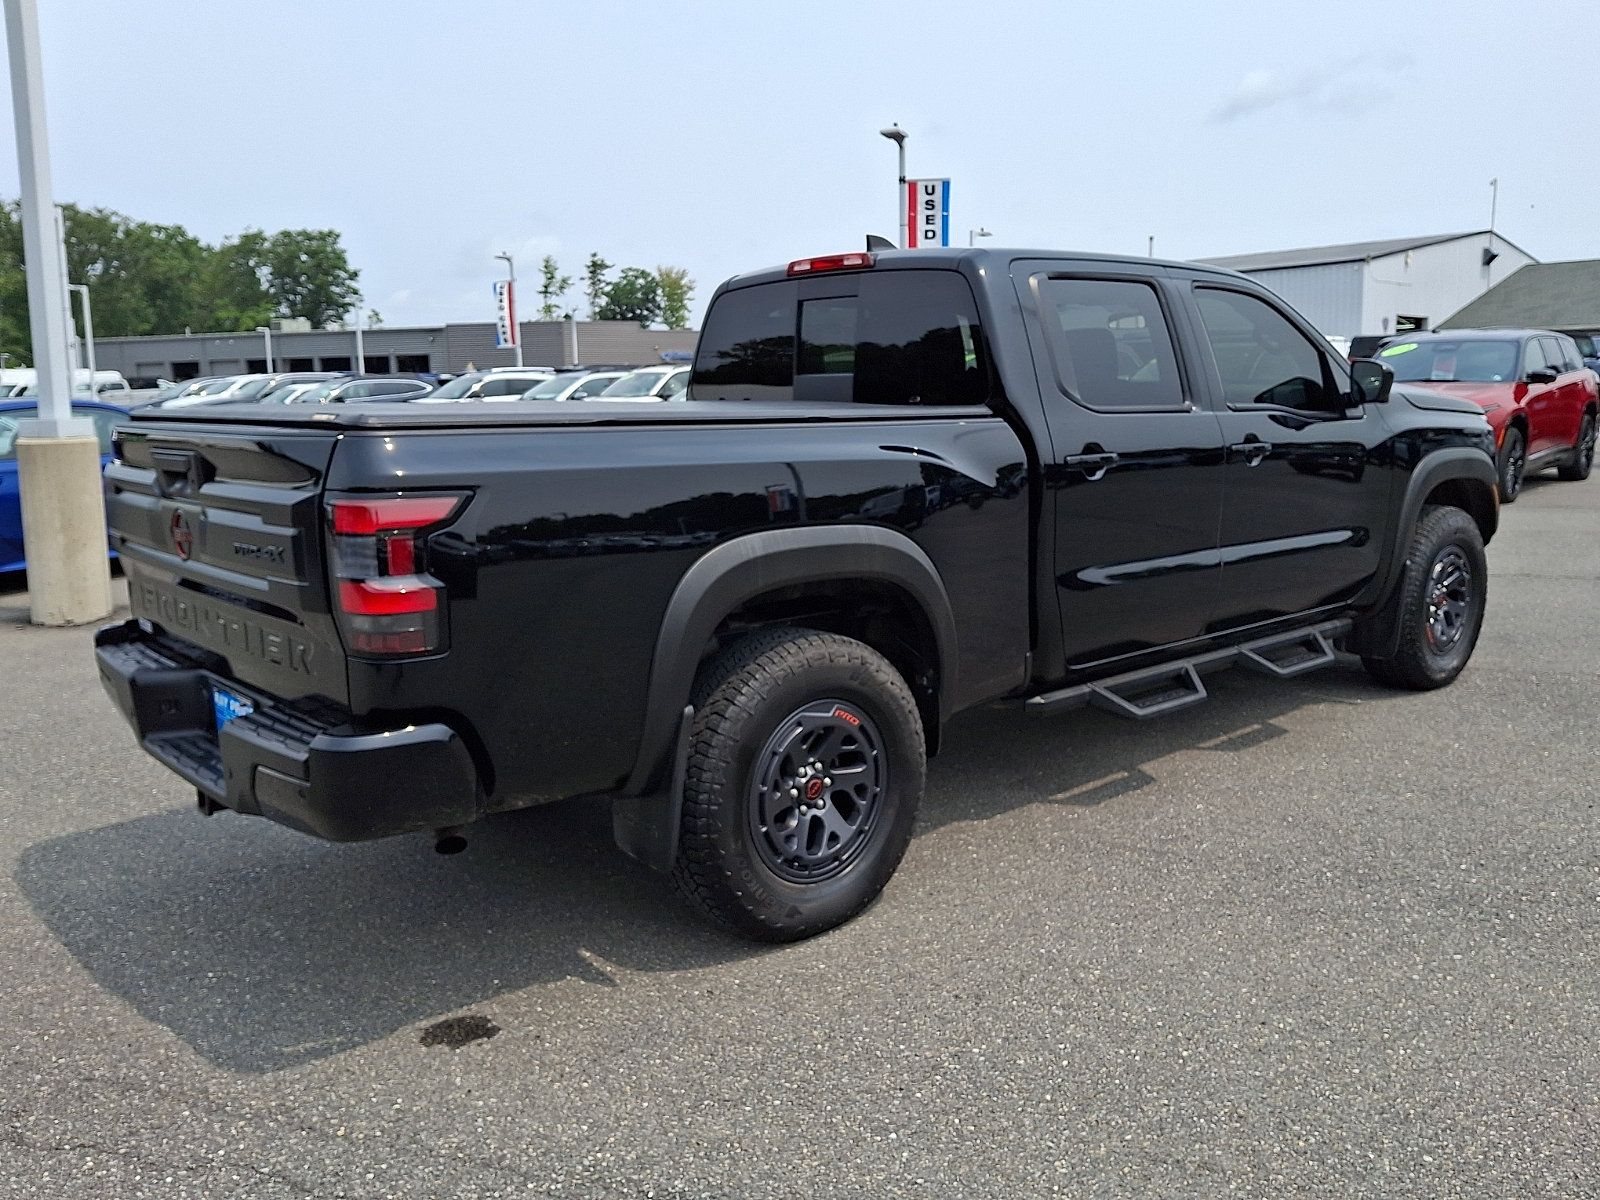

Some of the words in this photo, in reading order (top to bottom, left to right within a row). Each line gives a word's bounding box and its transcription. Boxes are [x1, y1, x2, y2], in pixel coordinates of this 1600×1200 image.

[924, 184, 936, 240] USED
[140, 582, 314, 676] FRONTIER
[834, 709, 860, 725] PRO
